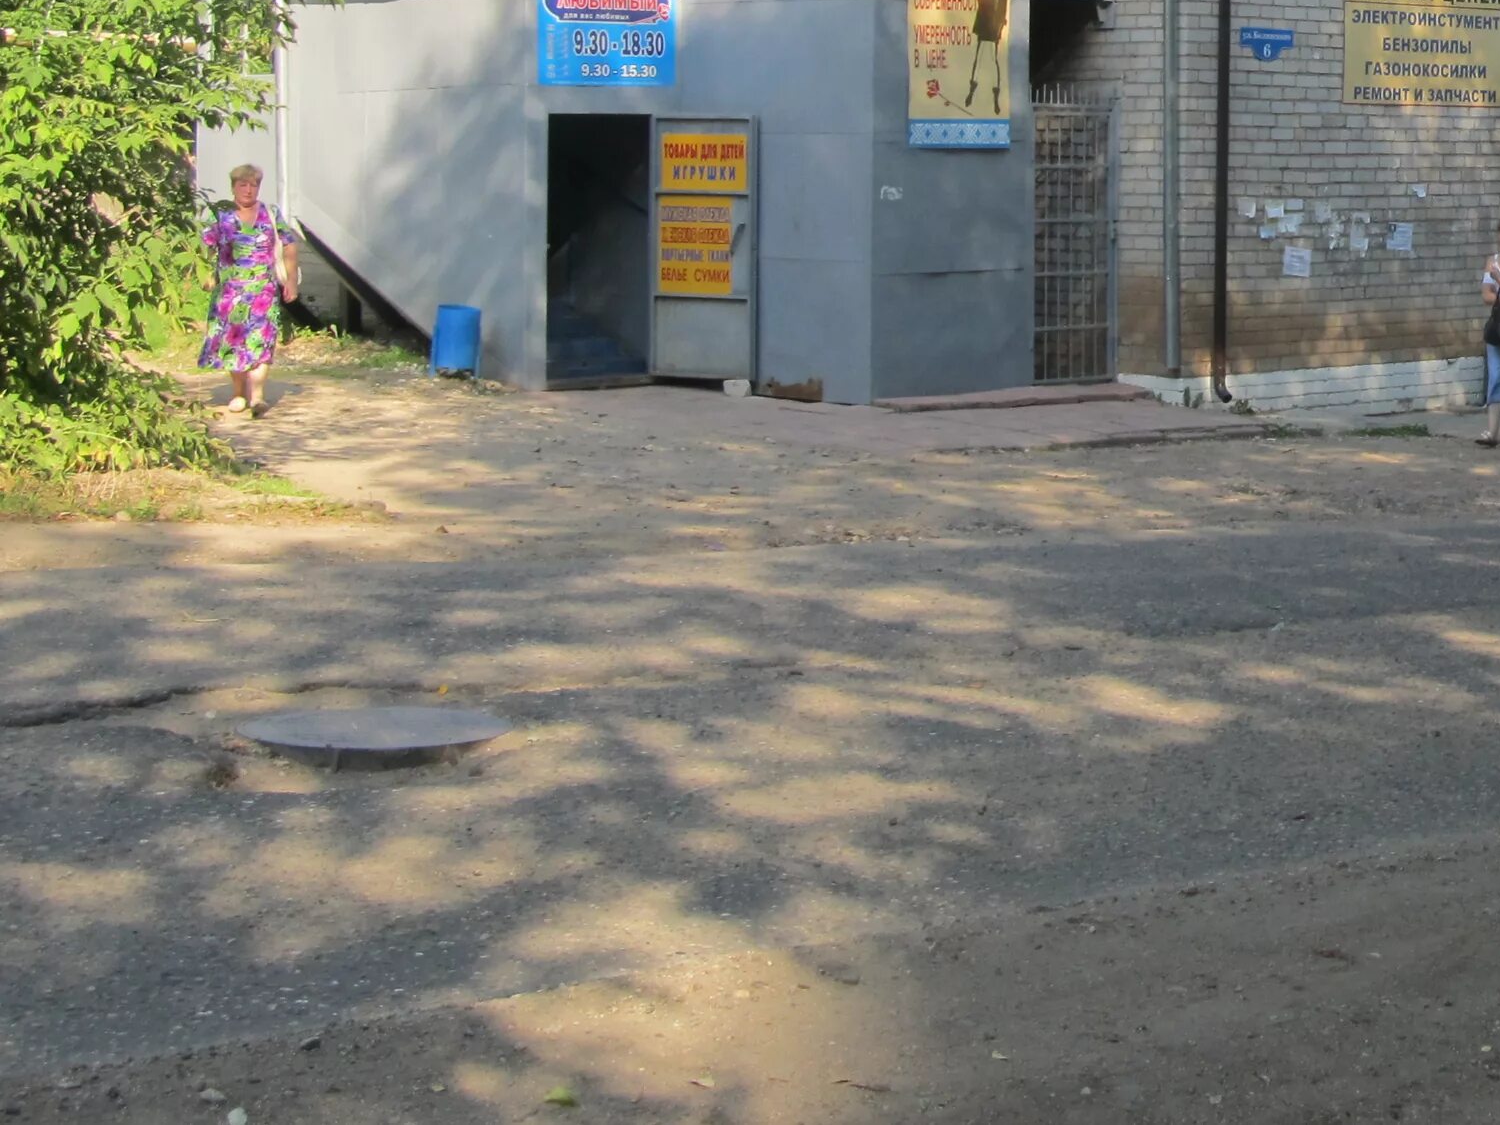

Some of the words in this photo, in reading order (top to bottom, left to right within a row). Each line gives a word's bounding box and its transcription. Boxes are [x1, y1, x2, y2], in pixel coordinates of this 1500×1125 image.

[1352, 10, 1500, 30] ЭЛЕКТРОИНСТУМЕНТ
[574, 28, 609, 56] 9.30
[622, 31, 666, 57] 18.30
[914, 25, 972, 46] УМЕРЕННОСТЬ
[1263, 43, 1272, 58] 6
[1382, 37, 1472, 54] БЕНЗОПИЛЫ
[914, 49, 920, 68] В
[926, 49, 948, 71] ЦЕНЕ
[581, 63, 610, 77] 9.30
[620, 65, 657, 78] 15.30
[1365, 61, 1487, 79] ГАЗОНОКОСИЛКИ
[1354, 86, 1410, 101] РЕМОНТ
[1415, 88, 1423, 101] И
[1427, 89, 1496, 103] ЗАПЧАСТИ
[664, 143, 697, 159] ТОВАРЫ
[701, 144, 717, 161] ДЛЯ
[720, 140, 744, 161] ДЕТЕЙ
[673, 165, 736, 181] ИГРУШКИ
[661, 269, 688, 282] БЕЛЬЕ
[694, 269, 730, 283] СУМКИ
